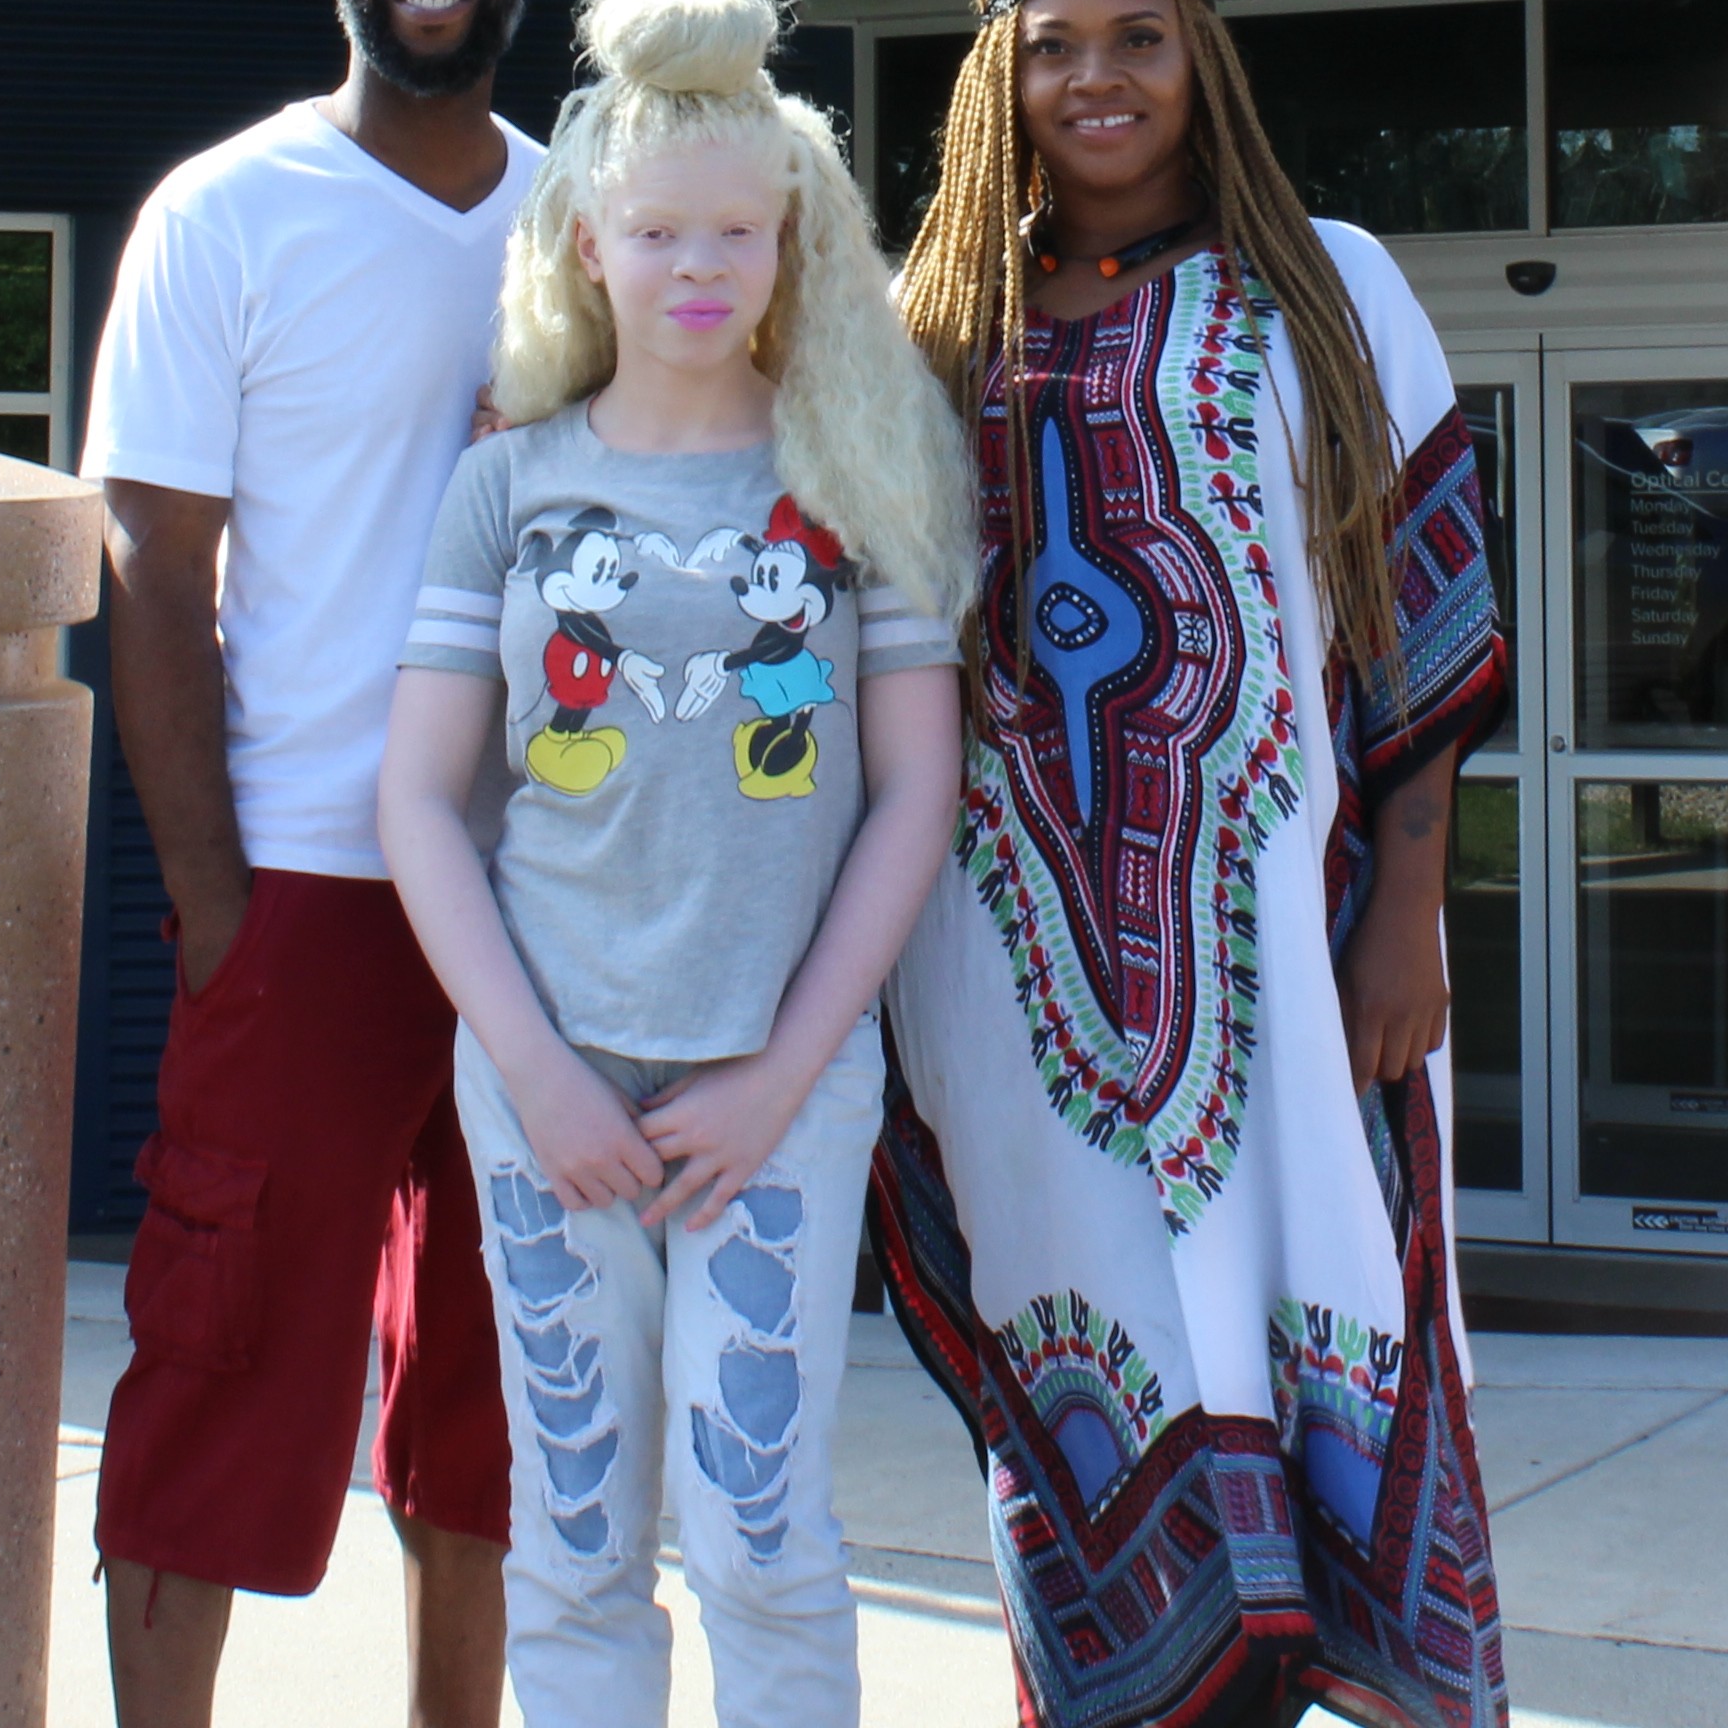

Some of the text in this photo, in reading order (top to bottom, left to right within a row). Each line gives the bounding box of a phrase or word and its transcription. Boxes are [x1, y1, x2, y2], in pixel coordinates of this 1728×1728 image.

[1631, 470, 1701, 491] Optical
[1630, 498, 1690, 514] Monday
[1632, 519, 1695, 537] Tuesday
[1630, 541, 1721, 559] Wednesday
[1632, 563, 1702, 582] Thursday
[1631, 585, 1678, 603] Friday
[1631, 608, 1699, 627] Saturday
[1631, 629, 1690, 648] Sunday
